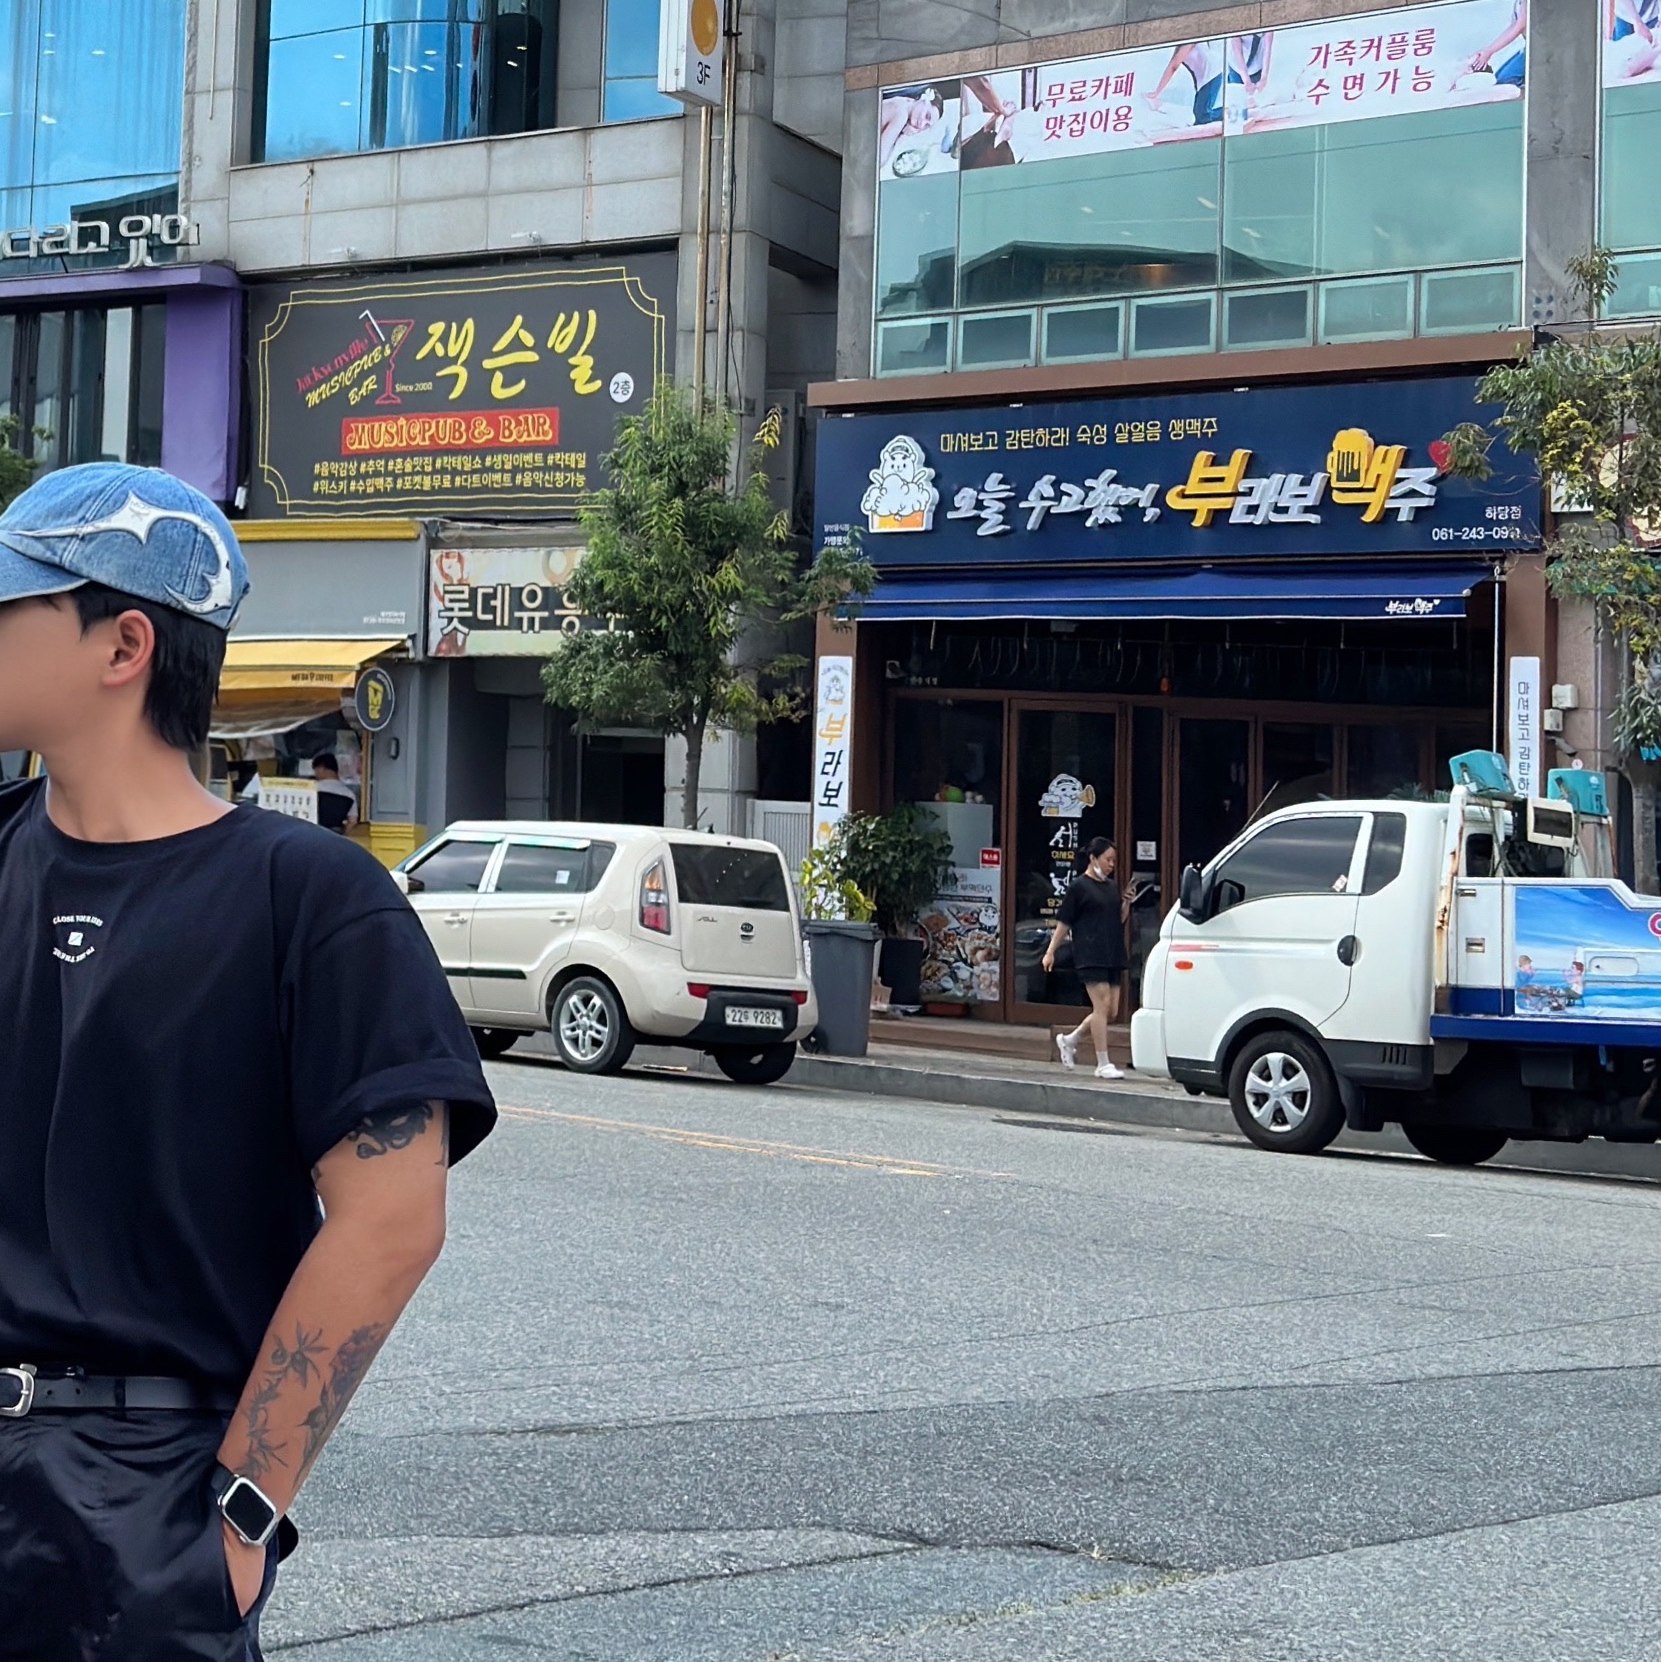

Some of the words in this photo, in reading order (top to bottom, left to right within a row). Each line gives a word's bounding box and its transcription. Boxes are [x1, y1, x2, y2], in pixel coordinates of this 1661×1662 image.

[1307, 28, 1436, 69] 가족커플룸
[697, 61, 711, 85] 3F
[1045, 72, 1134, 108] 무료카페
[1044, 105, 1133, 141] 맛집이용
[416, 309, 602, 401] 잭슨빌
[305, 345, 382, 408] MUSICPUB
[348, 375, 378, 406] BAR
[613, 380, 632, 396] 2층
[346, 416, 468, 450] MUSICPUB
[468, 416, 497, 443] &
[499, 413, 554, 443] BAR
[940, 431, 998, 453] 마셔보고
[1005, 426, 1070, 451] 감탄하라!
[1077, 423, 1107, 445] 숙성
[1114, 420, 1162, 443] 살얼음
[1168, 416, 1219, 441] 생맥주
[313, 480, 347, 494] #위스키
[454, 473, 513, 488] #다트이벤트
[515, 470, 585, 487] #음악신청가능
[359, 459, 385, 475] #추억
[485, 453, 545, 469] #생일이벤트
[946, 473, 1016, 537] 오늘
[1485, 505, 1521, 520] 하당점
[1517, 681, 1530, 741] 마셔보고
[1518, 746, 1531, 799] 감탄하
[53, 914, 74, 924] CLOSE
[752, 1010, 776, 1026] 9282
